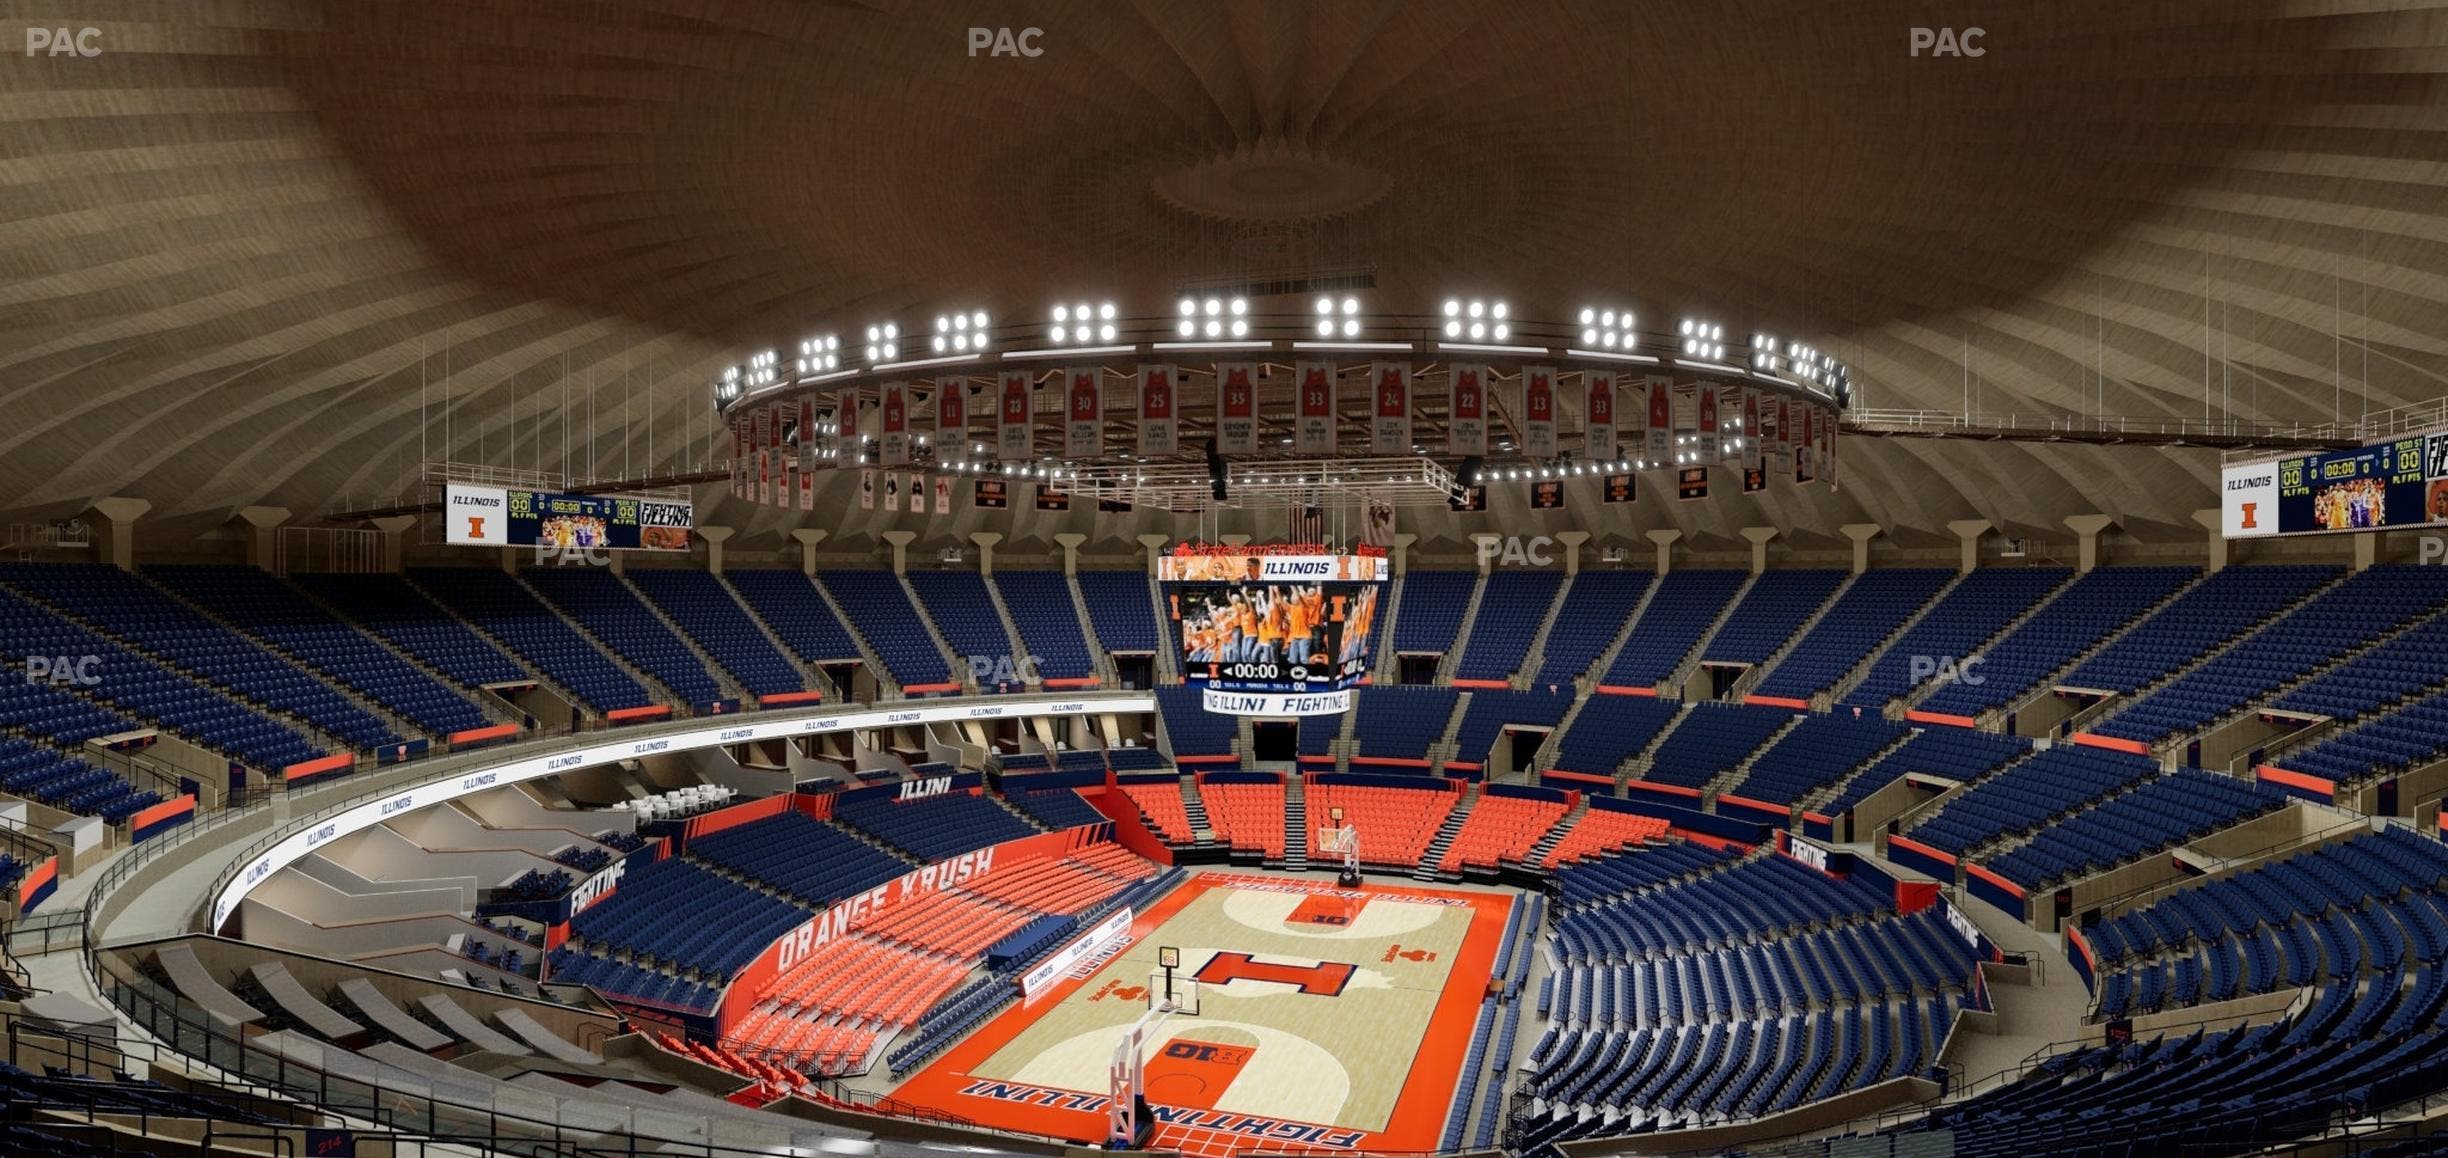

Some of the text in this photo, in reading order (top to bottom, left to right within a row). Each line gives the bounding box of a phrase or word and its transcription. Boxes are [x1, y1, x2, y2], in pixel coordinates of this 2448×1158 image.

[1077, 396, 1091, 410] 30
[1151, 395, 1164, 409] 25
[1231, 392, 1245, 406] 35
[1309, 392, 1324, 406] 33
[1461, 394, 1475, 408] 22
[2400, 451, 2419, 469] 00
[2326, 461, 2355, 477] 00:00
[2227, 476, 2272, 491] ILLINOIS
[2283, 470, 2300, 486] 00
[453, 495, 500, 507] ILLINOIS
[511, 499, 528, 510] 00
[554, 502, 579, 511] 00:00
[620, 507, 634, 517] 00
[643, 503, 691, 517] FIGHTING
[642, 514, 692, 526] ILLINI
[1264, 562, 1330, 574] ILLINOIS
[1234, 663, 1278, 679] 00:00
[1209, 680, 1221, 689] 00
[1293, 681, 1306, 692] 00
[1051, 703, 1084, 712] ILLINOIS
[1220, 696, 1267, 711] ILLINI
[1282, 696, 1344, 711] FIGHTING
[888, 712, 921, 722] ILLINOIS
[970, 707, 1002, 717] ILLINOIS
[805, 719, 838, 730] ILLINOIS
[720, 728, 753, 740] ILLINOIS
[634, 740, 668, 754] ILLINOIS
[548, 755, 582, 770] ILLINOIS
[463, 773, 497, 791] ILLINOIS
[900, 776, 952, 800] ILLINI
[381, 796, 412, 816] ILLINOIS
[307, 823, 336, 848] ILLINOIS
[246, 859, 270, 887] ILLINOIS
[570, 859, 627, 918] FIGHTING
[778, 847, 995, 972] ORANGE KRUSH
[1111, 913, 1130, 929] ILLINOIS
[1946, 903, 1979, 949] FIGHTING
[1071, 936, 1095, 957] ILLINOIS
[1028, 964, 1054, 987] ILLINOIS
[957, 1079, 1112, 1113] ILLINI
